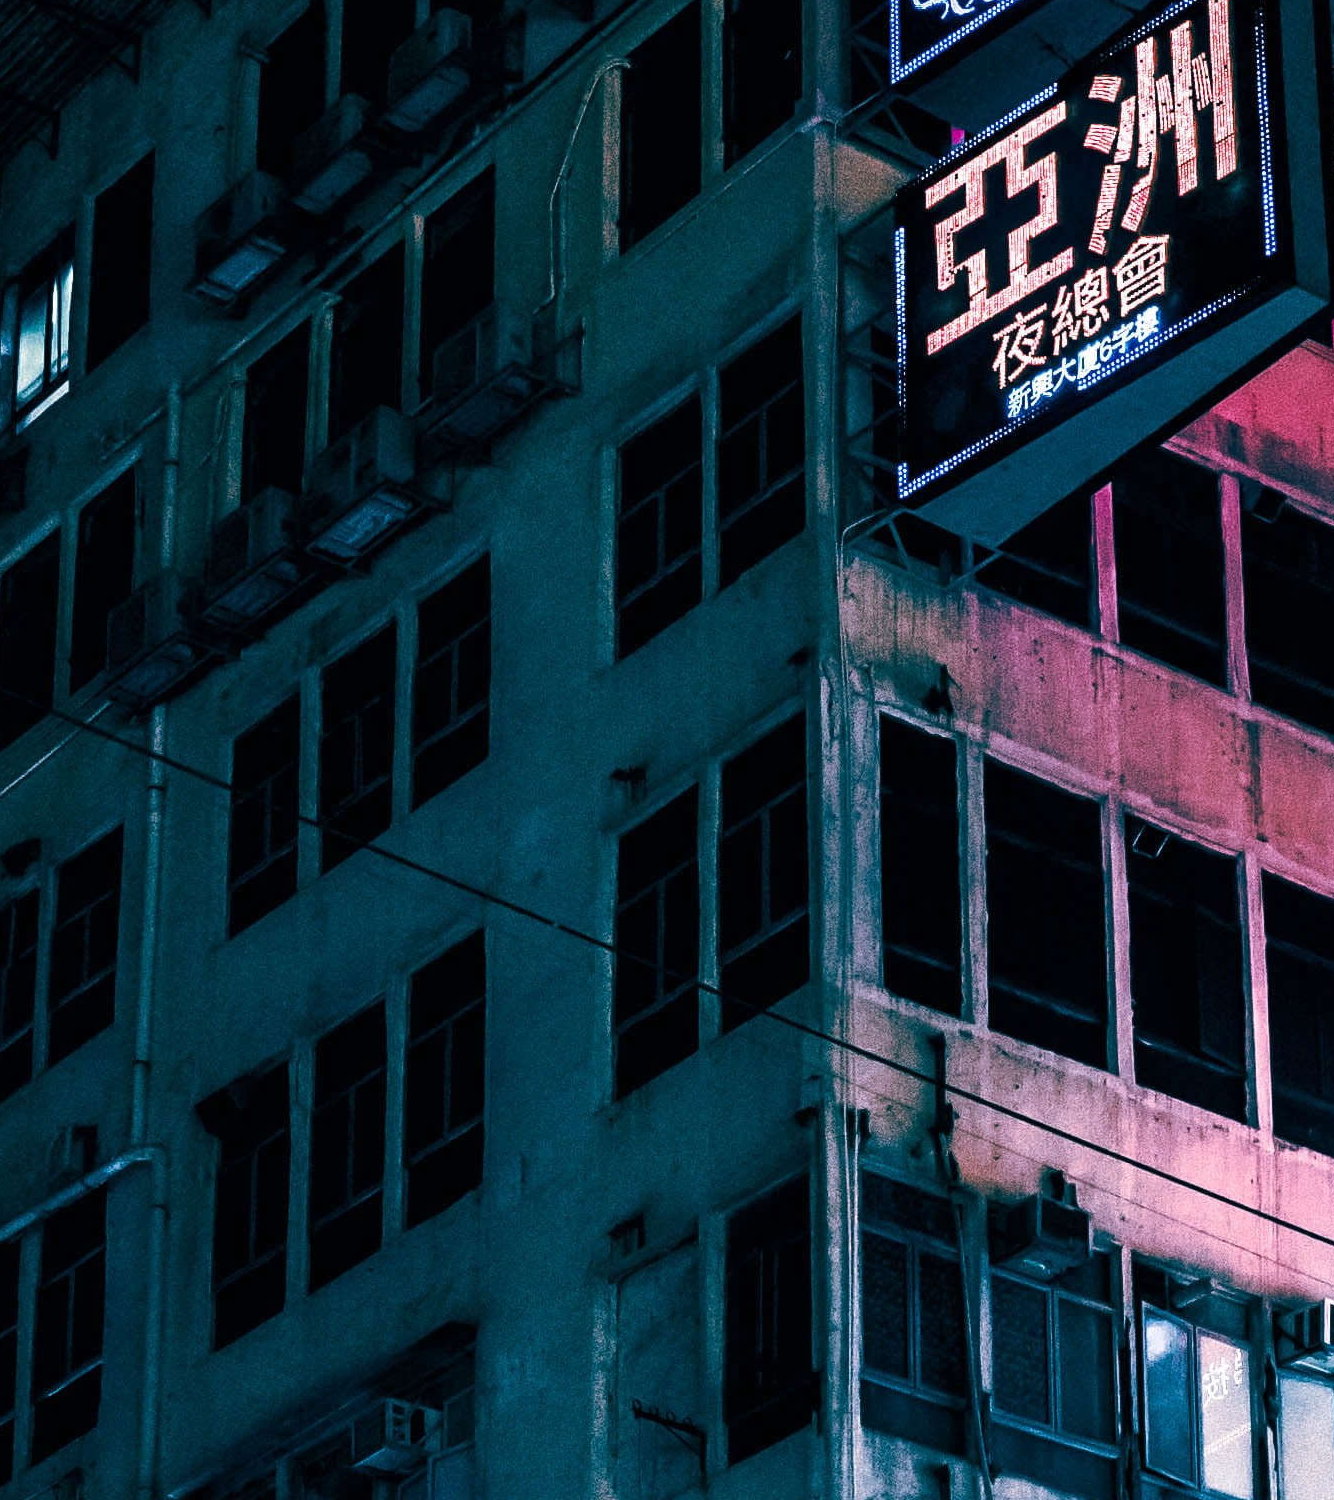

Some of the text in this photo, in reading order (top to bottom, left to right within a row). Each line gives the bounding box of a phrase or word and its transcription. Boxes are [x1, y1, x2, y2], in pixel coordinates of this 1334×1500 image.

[992, 233, 1170, 390] 夜總會
[1007, 305, 1160, 419] 新興大廈6字樓
